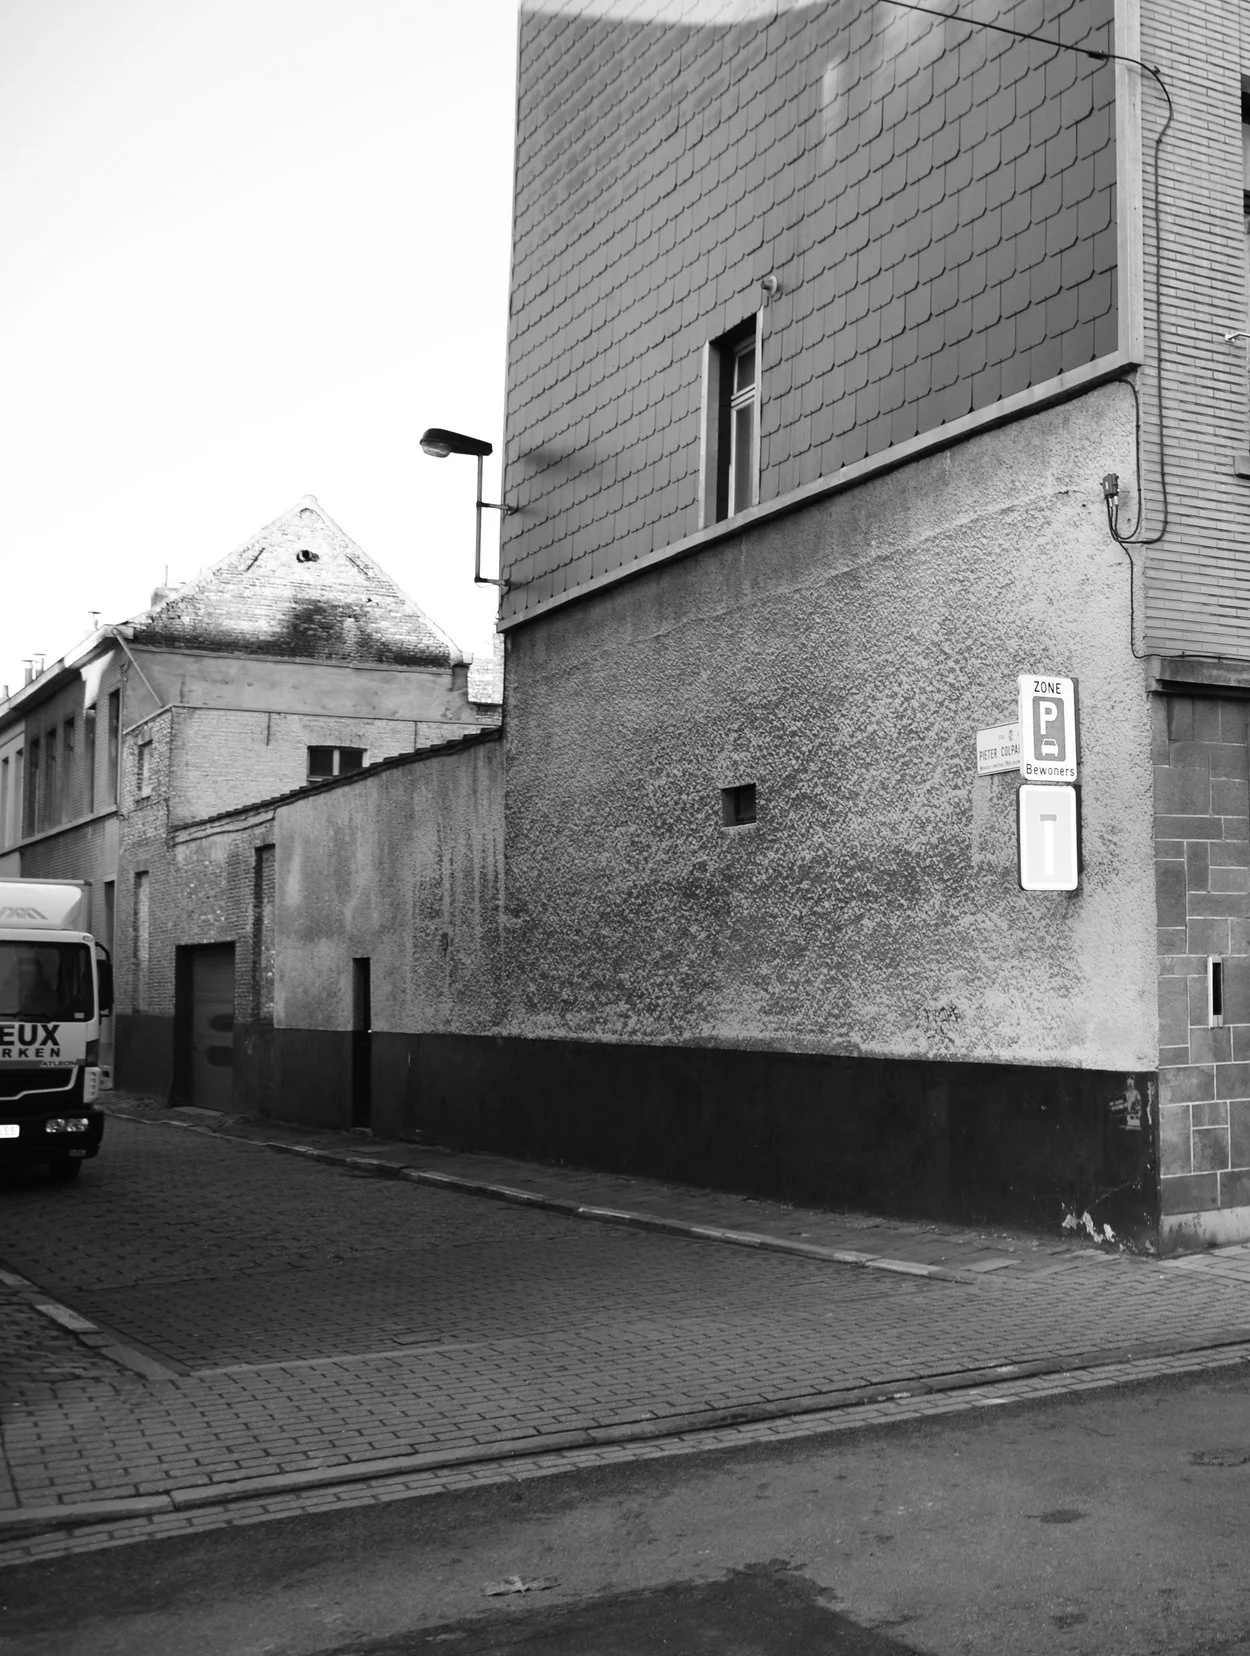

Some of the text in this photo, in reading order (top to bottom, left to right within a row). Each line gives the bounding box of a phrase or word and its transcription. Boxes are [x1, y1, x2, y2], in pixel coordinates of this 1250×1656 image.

[1033, 680, 1062, 694] ZONE
[1039, 700, 1058, 735] P
[979, 744, 1020, 761] PIETER COLPA
[1026, 763, 1075, 777] Bewoners
[0, 1024, 60, 1047] EUX
[2, 1047, 61, 1058] RKEN
